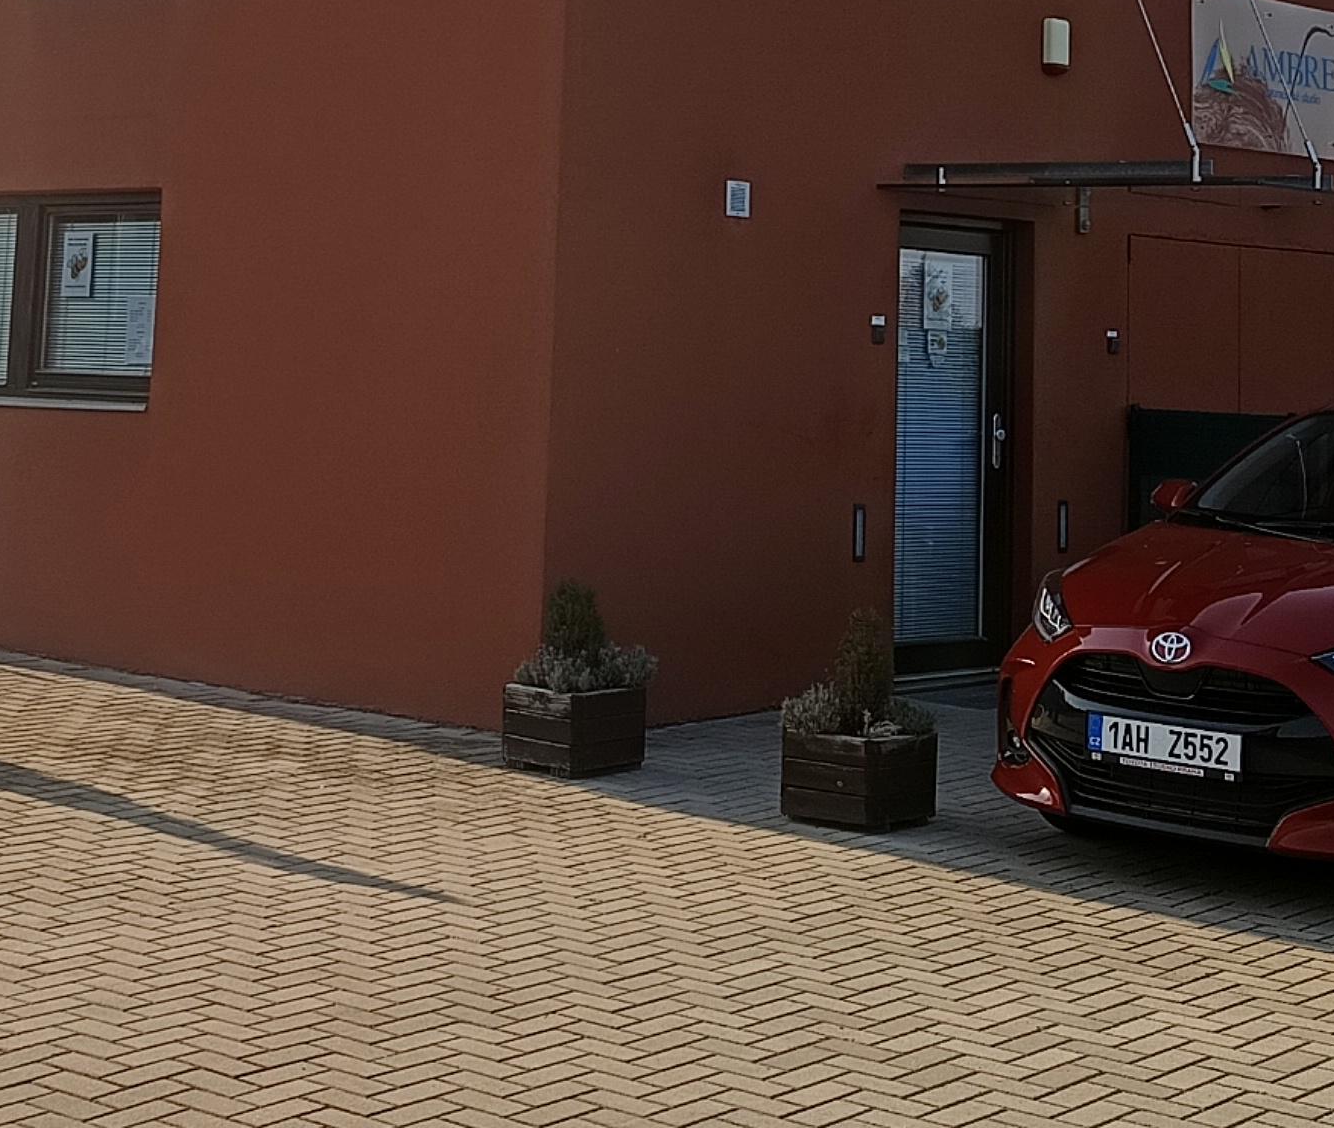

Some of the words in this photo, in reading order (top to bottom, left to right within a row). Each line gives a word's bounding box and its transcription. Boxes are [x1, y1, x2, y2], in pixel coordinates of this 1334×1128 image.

[1089, 736, 1101, 746] CZ
[1108, 722, 1149, 754] 1AH
[1168, 729, 1229, 766] Z552
